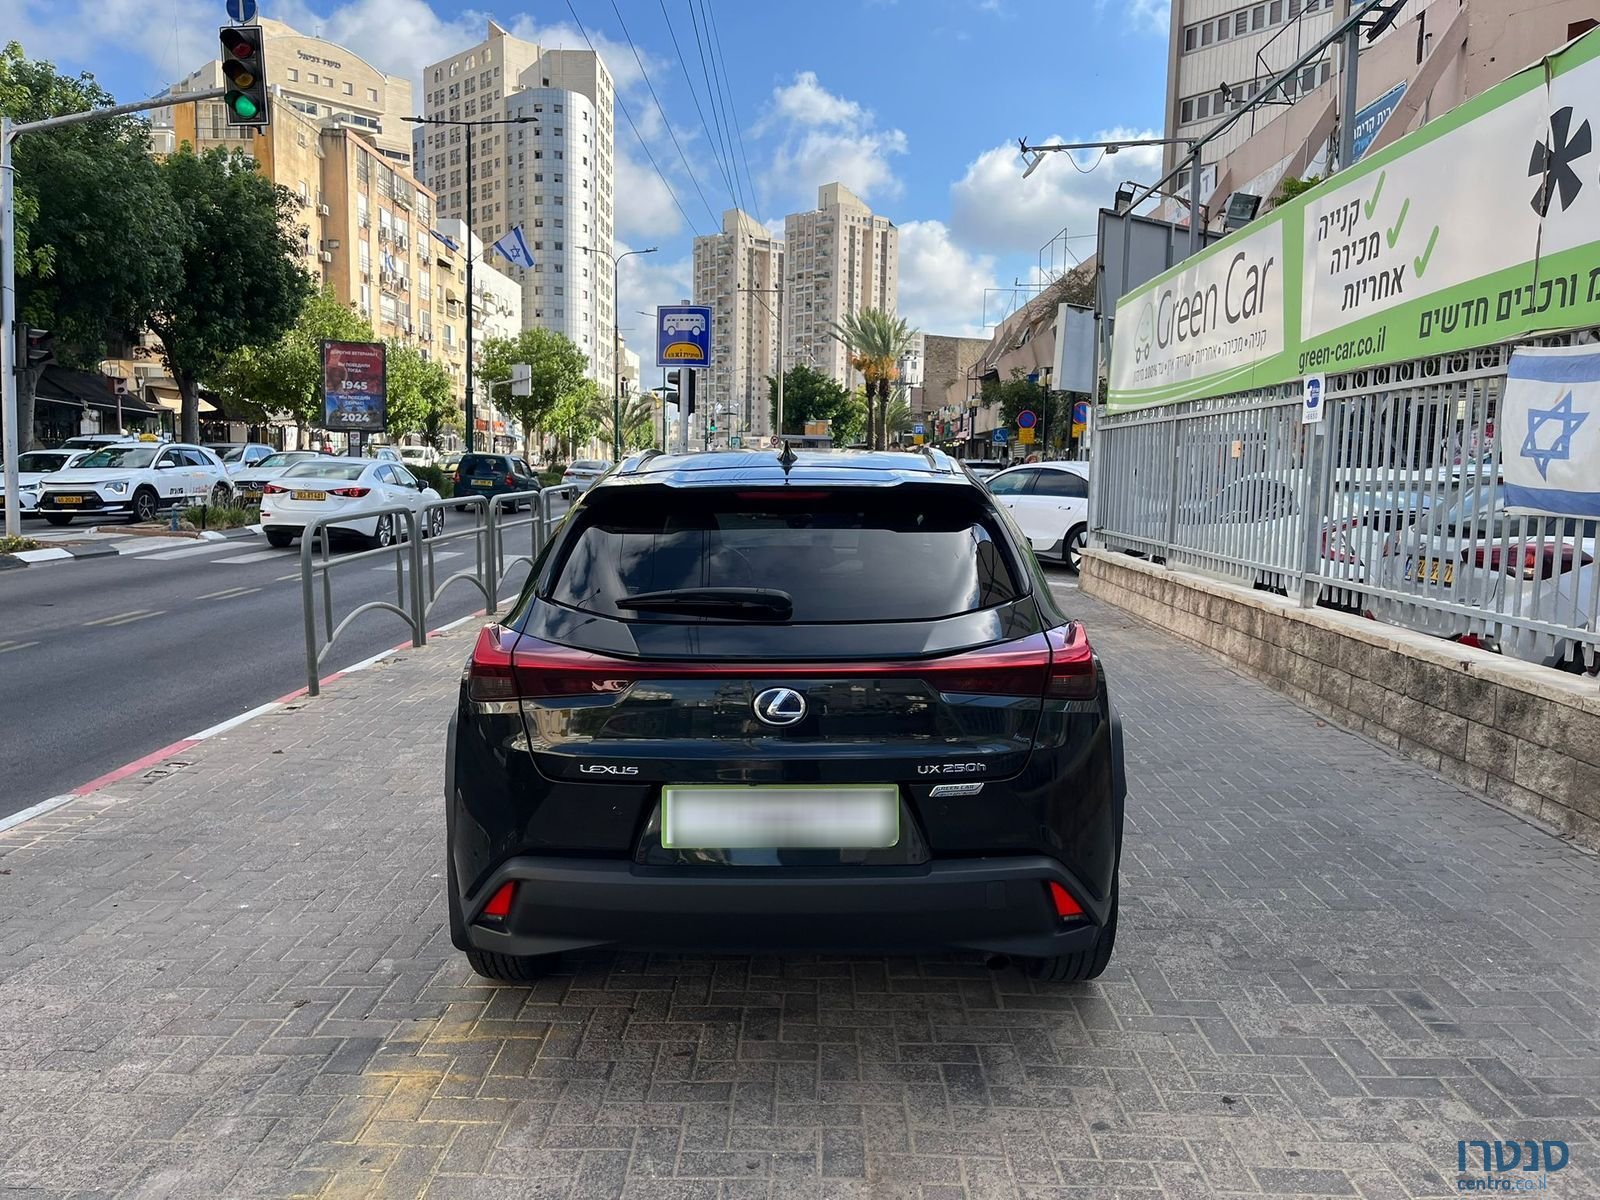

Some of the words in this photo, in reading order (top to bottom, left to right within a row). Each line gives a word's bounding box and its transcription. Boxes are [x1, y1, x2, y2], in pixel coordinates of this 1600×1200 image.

[1318, 198, 1360, 242] קנייה
[1330, 231, 1380, 275] מכירה
[1156, 283, 1218, 350] Green
[1224, 251, 1274, 324] Car
[1341, 264, 1406, 312] אחריות
[1496, 274, 1578, 322] ורכבים
[1418, 296, 1489, 338] חדשים
[1298, 325, 1386, 374] green-car.co.il
[341, 380, 368, 390] 1945
[341, 413, 370, 422] 2024
[580, 764, 638, 774] LEXUS
[917, 764, 940, 774] UX
[942, 762, 986, 773] 250h
